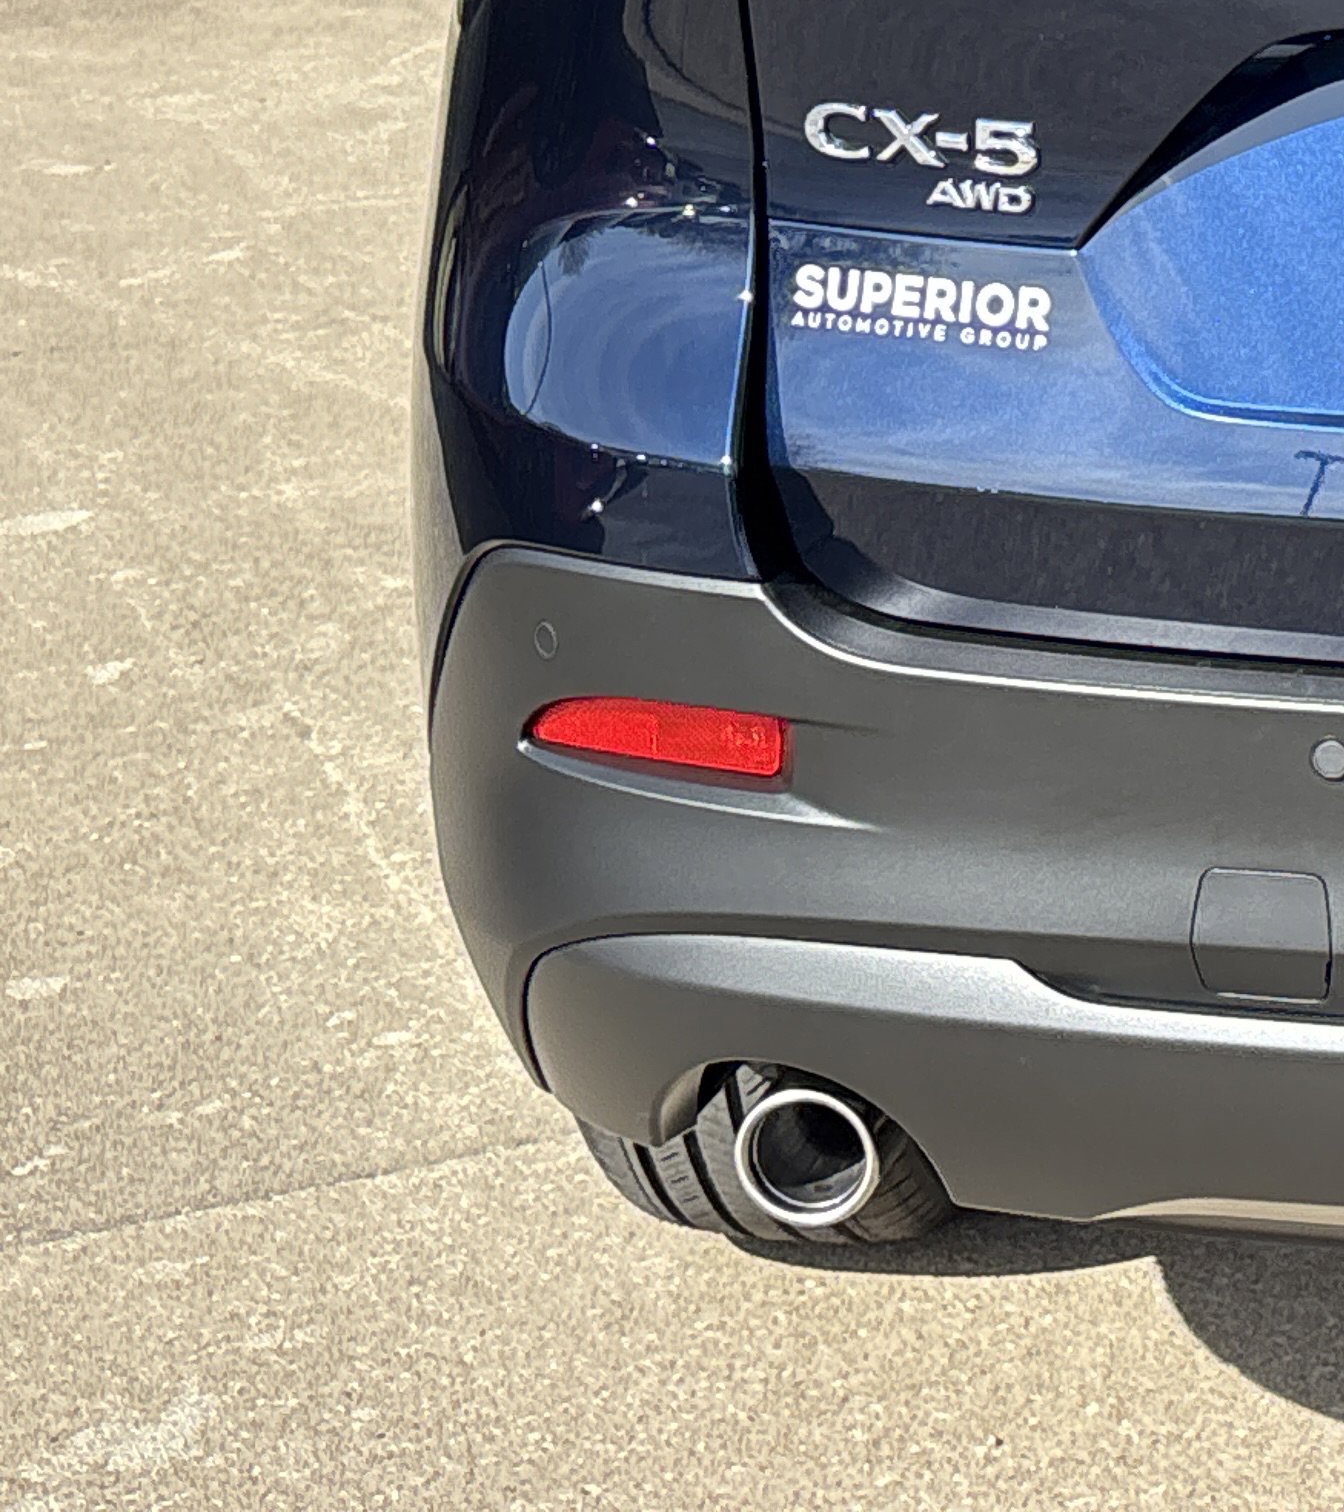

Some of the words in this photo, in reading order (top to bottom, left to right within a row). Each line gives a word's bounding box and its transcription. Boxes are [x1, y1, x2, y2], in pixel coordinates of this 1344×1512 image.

[804, 102, 1038, 176] CX-5
[926, 178, 1034, 214] AWD
[793, 264, 1052, 332] SUPERIOR
[791, 310, 947, 342] AUTOMOTIVE
[959, 327, 1049, 351] GROUP
